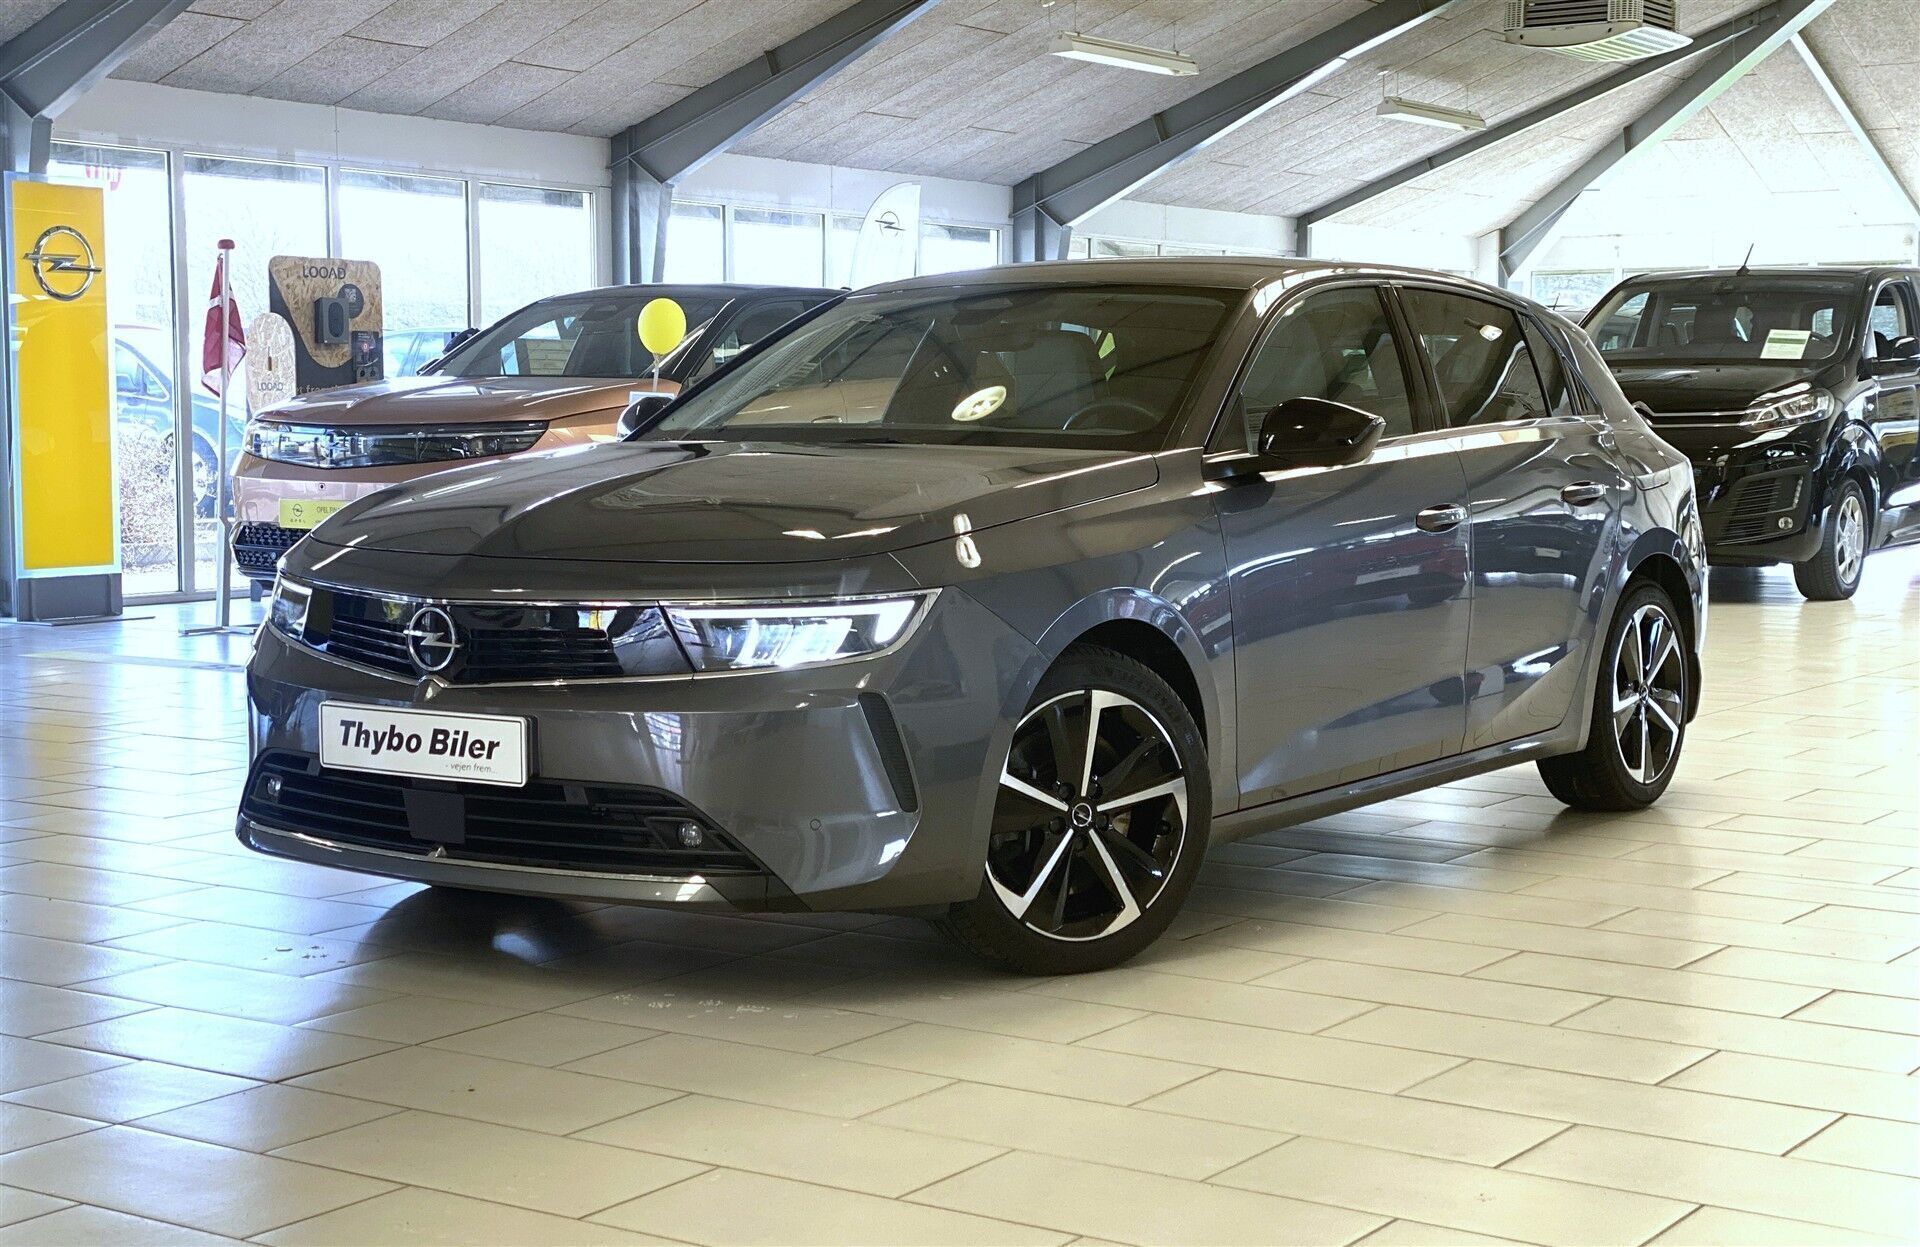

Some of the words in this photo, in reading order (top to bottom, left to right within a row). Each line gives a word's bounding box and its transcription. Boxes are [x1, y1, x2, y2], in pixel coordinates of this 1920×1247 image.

[302, 266, 346, 280] LOOAD
[257, 382, 284, 391] LOOAD
[339, 719, 422, 755] Thybo
[428, 728, 501, 760] Biler
[450, 763, 472, 773] vejen
